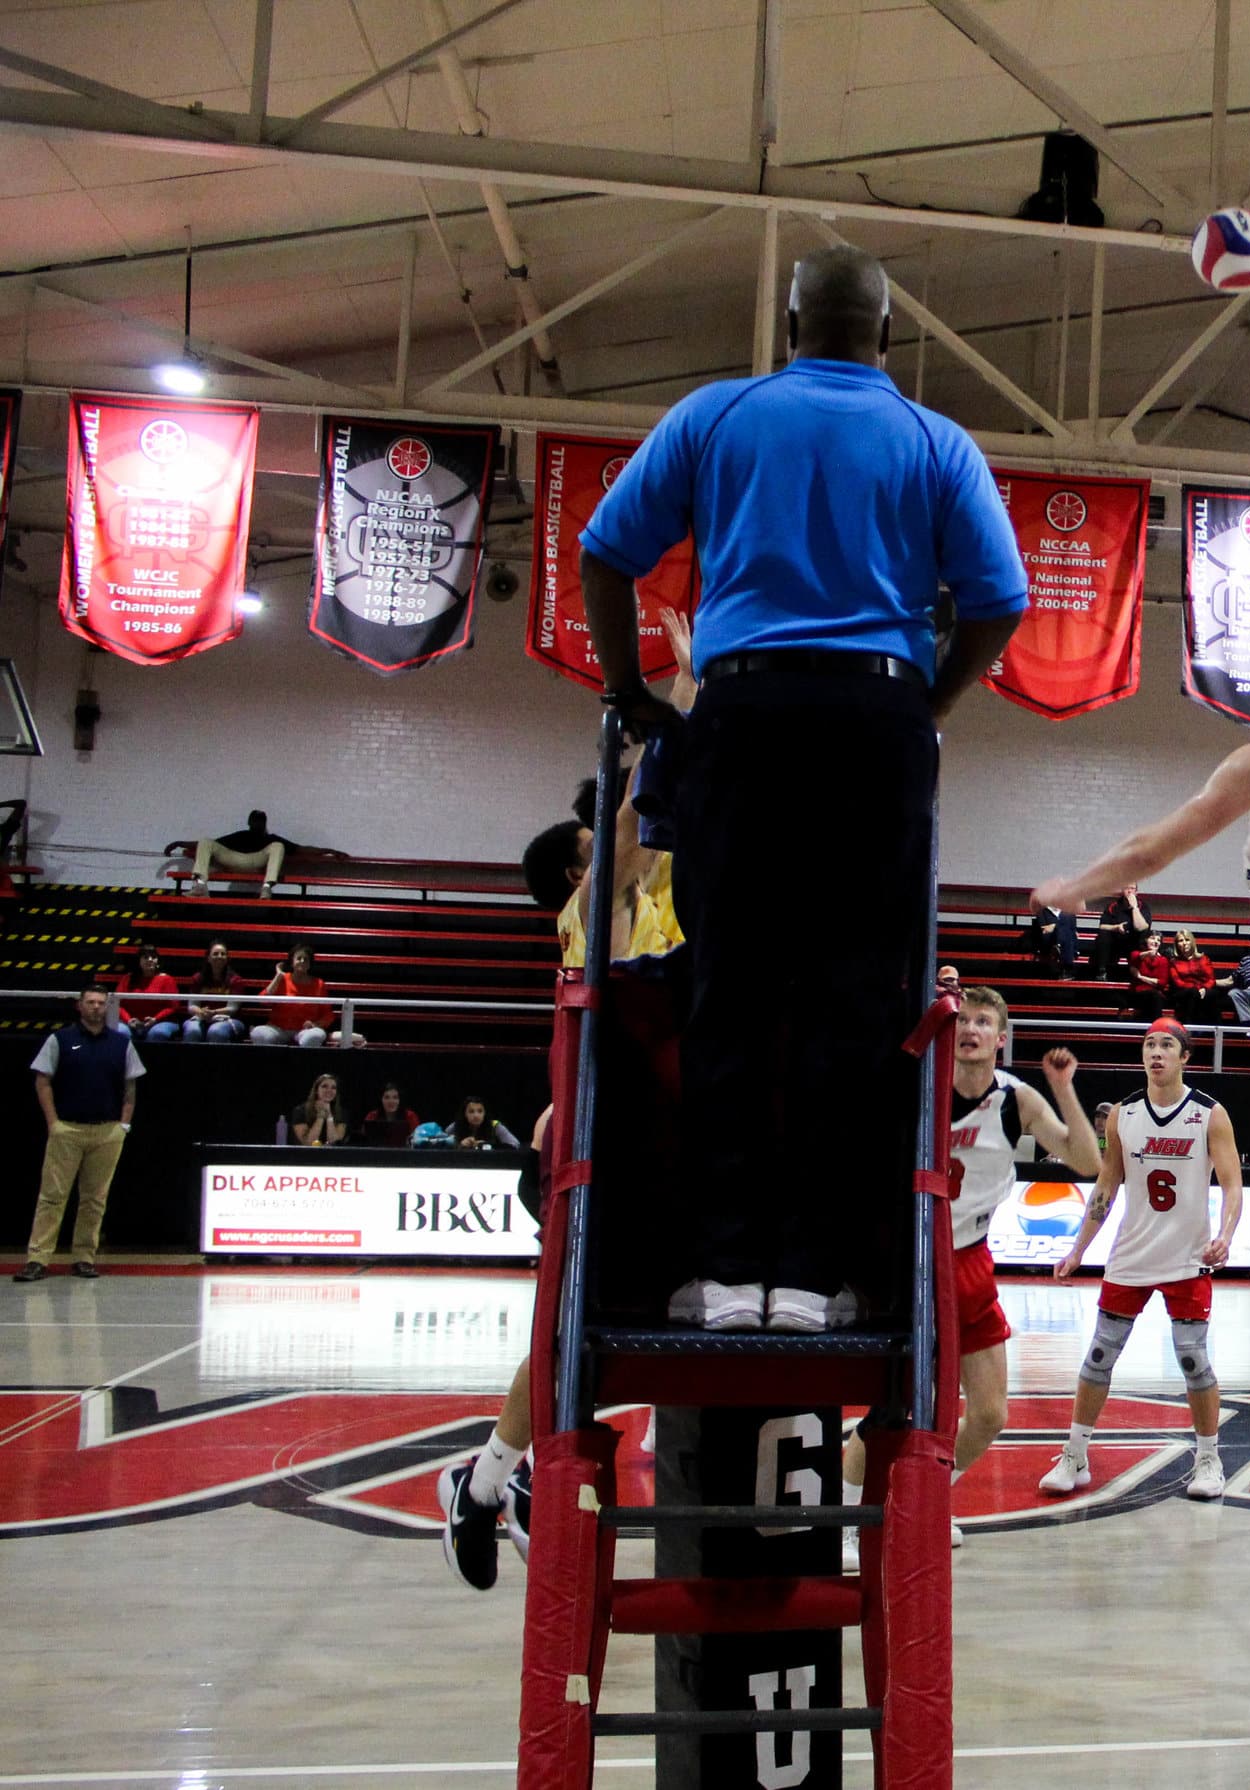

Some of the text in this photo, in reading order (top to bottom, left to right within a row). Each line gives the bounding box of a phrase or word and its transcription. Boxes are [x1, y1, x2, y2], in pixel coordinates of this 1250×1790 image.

[375, 489, 435, 505] NJCAA
[322, 426, 352, 596] MEN'S BASKETBALL
[367, 503, 441, 521] Region X
[356, 515, 449, 536] Champions
[369, 536, 434, 552] 1956-57
[541, 446, 565, 648] WOMEN'S BASKETBALL
[1039, 538, 1091, 551] NCCAA
[368, 550, 432, 567] 1957-58
[1023, 551, 1107, 568] Tournament
[75, 529, 94, 618] WOMEN'S
[133, 568, 179, 582] WCJC
[366, 565, 430, 581] 1972-73
[1036, 572, 1093, 585] National
[107, 583, 202, 599] Tournament
[1029, 584, 1097, 599] Runner-up
[110, 600, 196, 616] Champions
[364, 593, 427, 609] 1988-89
[1036, 598, 1090, 611] 2004-05
[362, 608, 425, 623] 1989-90
[123, 621, 182, 633] 1985-86
[1144, 1136, 1195, 1156] NGU
[212, 1174, 365, 1193] DLK APPAREL
[1147, 1169, 1177, 1212] 6
[396, 1191, 521, 1233] BB&T
[219, 1231, 355, 1246] www.ngcrusaders.com
